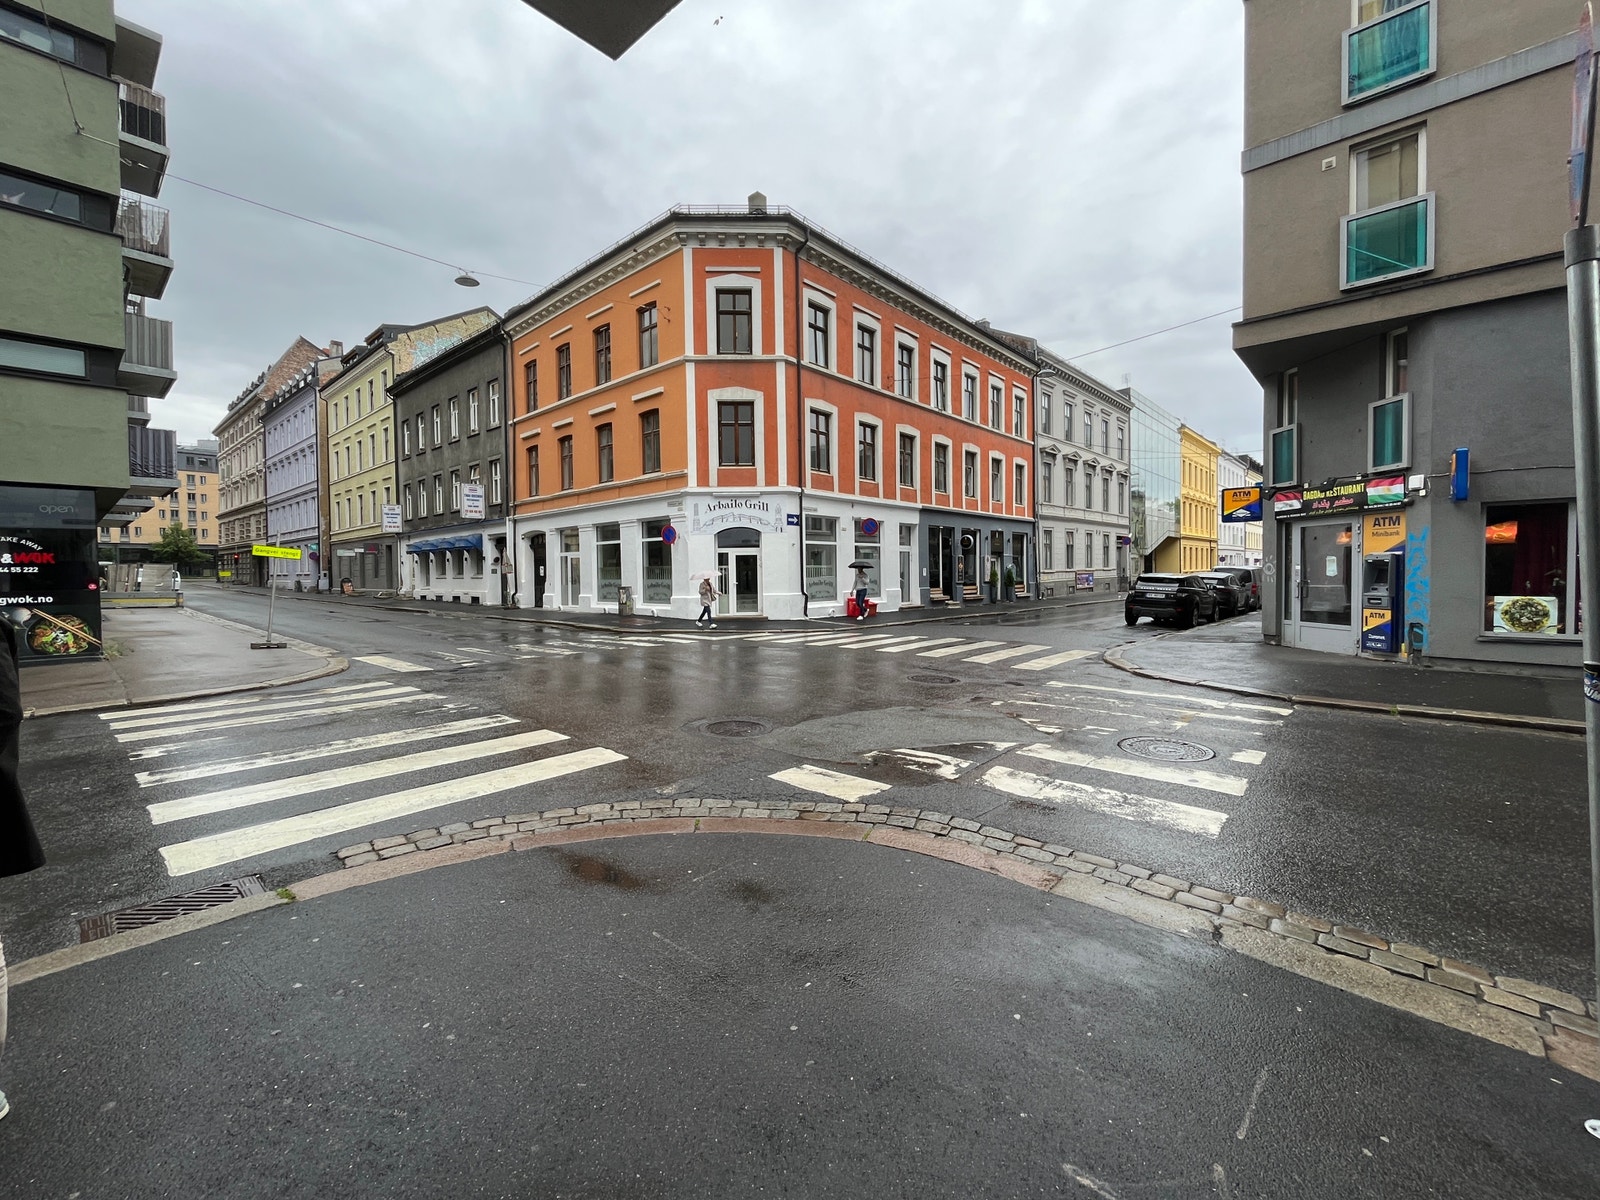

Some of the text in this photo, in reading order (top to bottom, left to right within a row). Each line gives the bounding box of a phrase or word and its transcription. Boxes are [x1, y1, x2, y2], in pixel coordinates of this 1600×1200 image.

[1326, 483, 1365, 497] RESTAURANT
[39, 504, 74, 514] open
[705, 499, 769, 513] Arbailo Grill
[1372, 515, 1401, 528] ATM
[20, 539, 43, 551] AWAY
